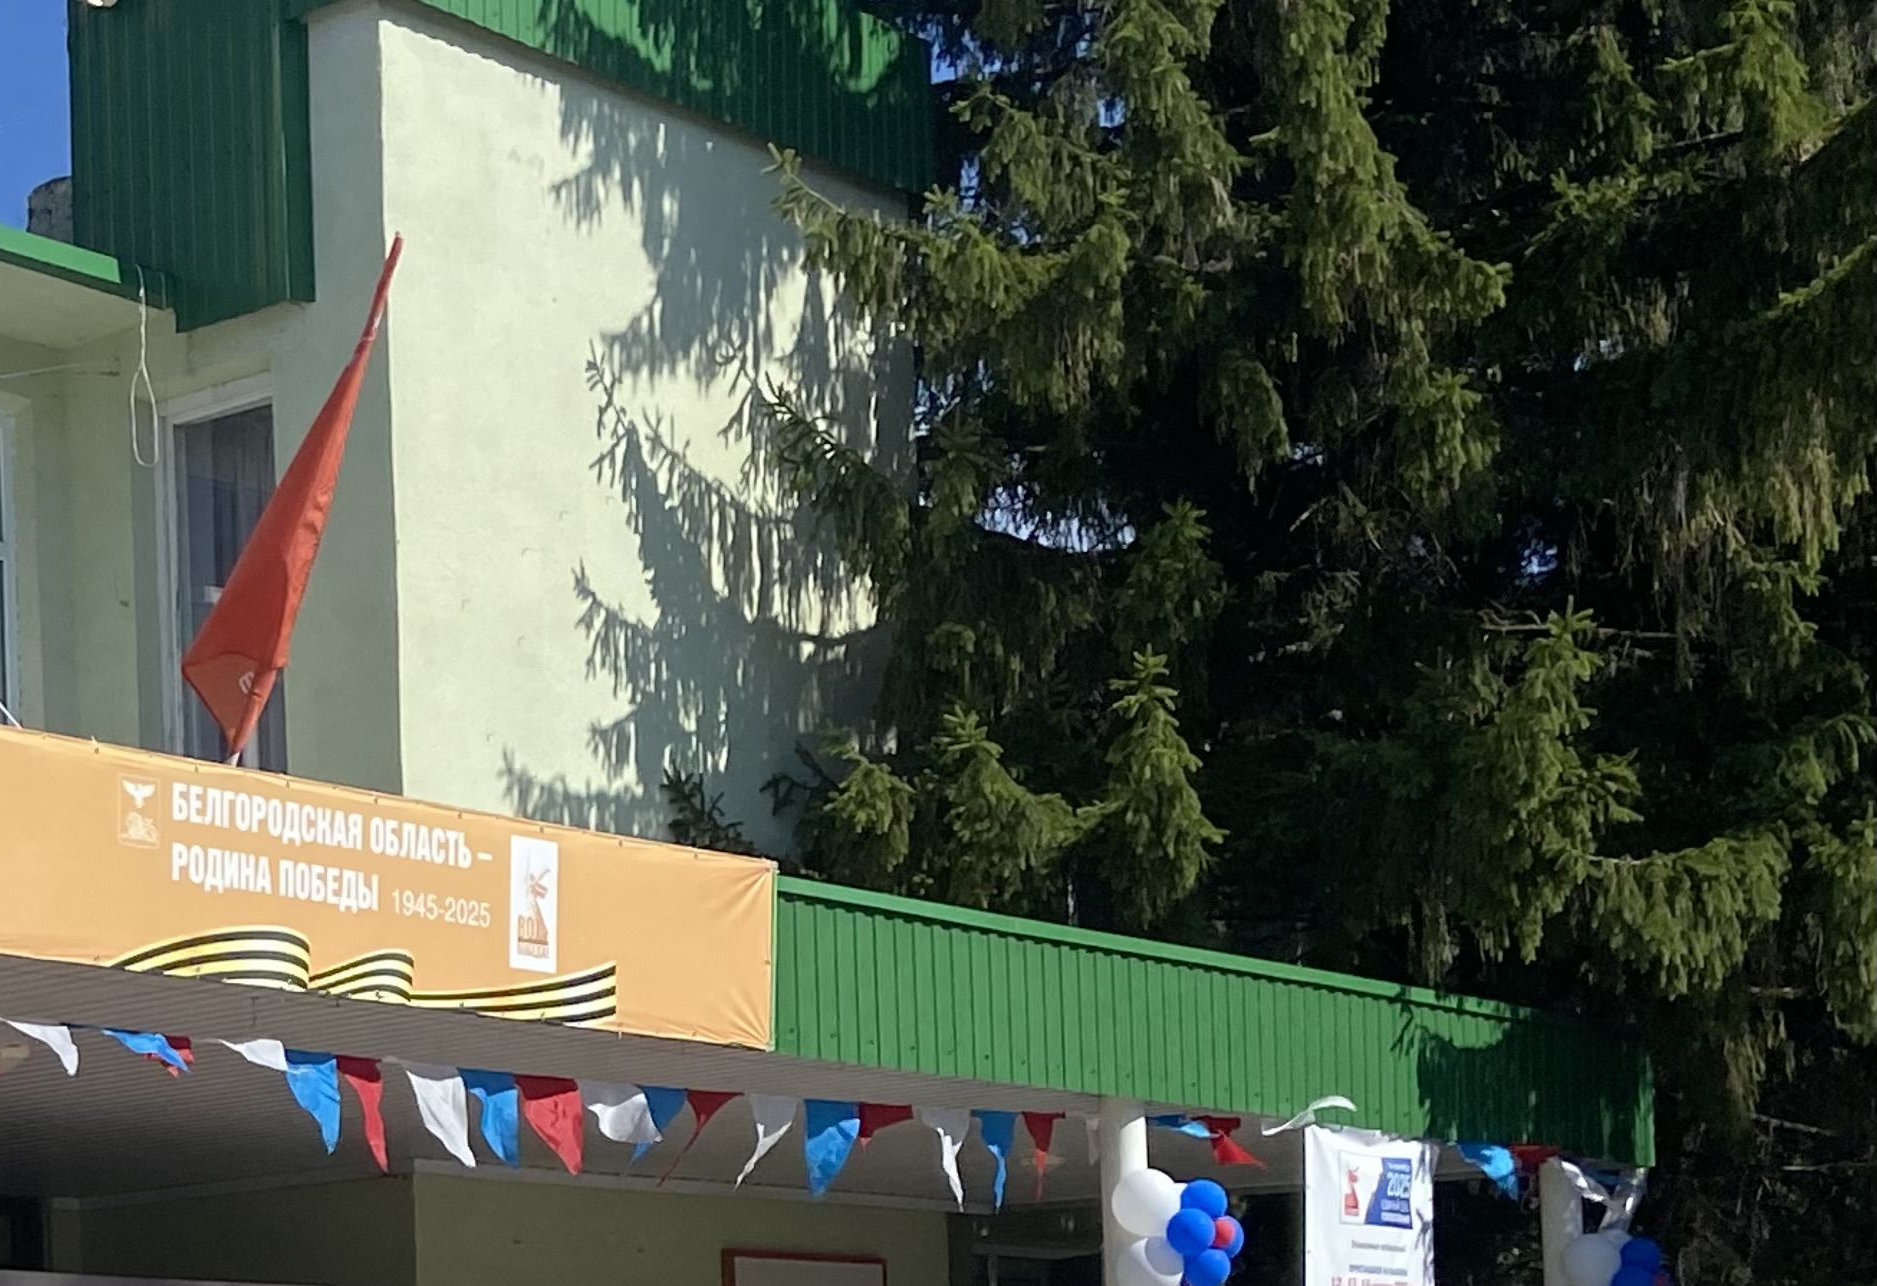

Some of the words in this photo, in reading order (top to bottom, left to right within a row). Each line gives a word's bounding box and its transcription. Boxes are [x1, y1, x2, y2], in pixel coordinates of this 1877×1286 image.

[172, 782, 364, 853] БЕЛГОРОДСКАЯ
[369, 816, 472, 869] ОБЛАСТЬ
[172, 842, 272, 894] РОДИНА
[280, 860, 379, 913] ПОБЕДЫ
[391, 888, 491, 928] 1945-2025
